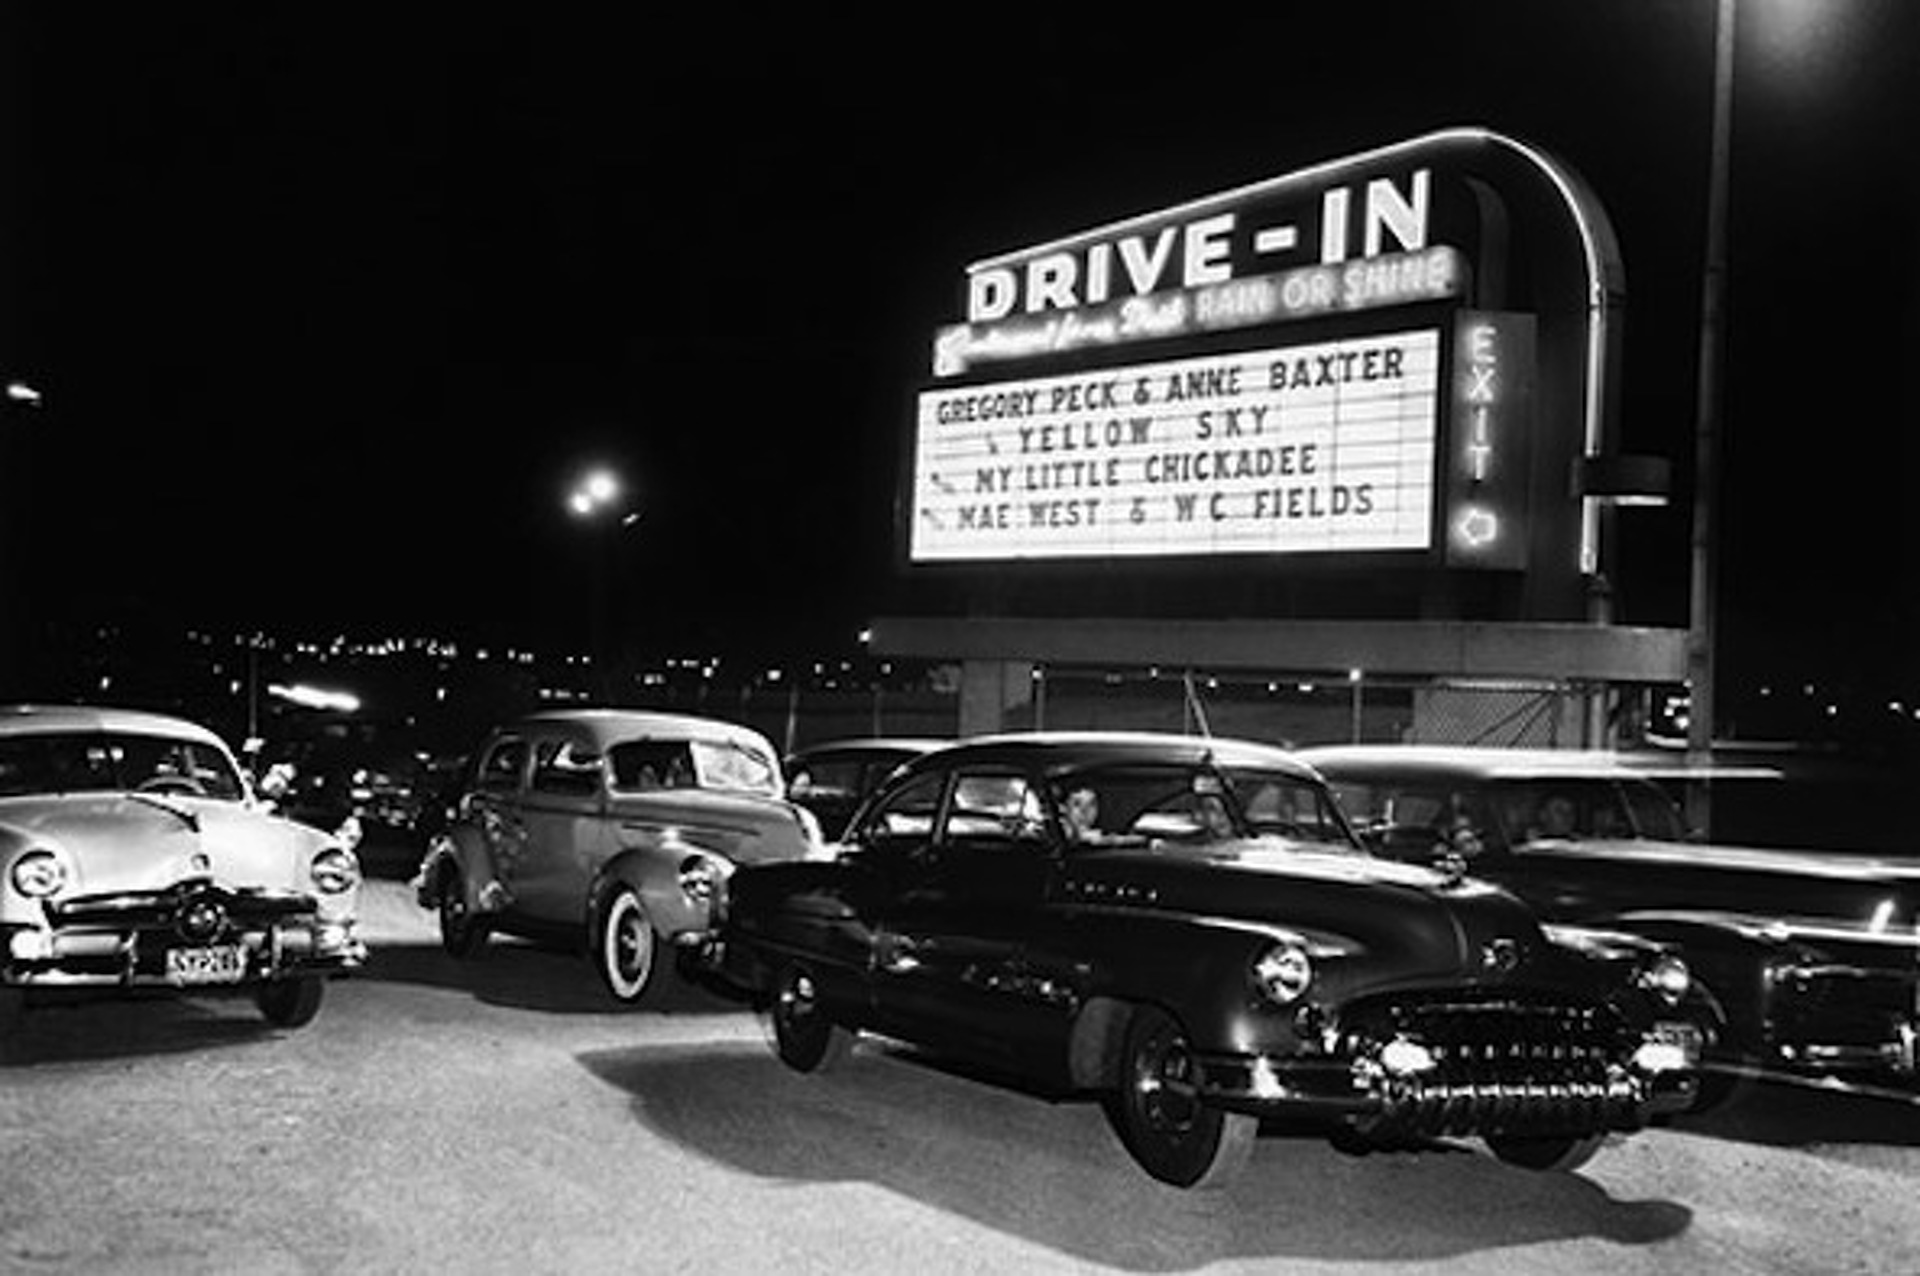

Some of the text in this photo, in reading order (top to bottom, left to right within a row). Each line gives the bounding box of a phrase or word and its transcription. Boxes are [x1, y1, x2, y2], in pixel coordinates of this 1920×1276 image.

[1196, 279, 1275, 322] RAIN
[1282, 268, 1337, 312] OR
[937, 347, 1404, 425] GREGORY PECK & ANNE BAXTER
[1469, 325, 1497, 481] EXIT
[1018, 405, 1269, 454] YELLOW SKY
[974, 443, 1317, 493] MY LITTLE CHICKADEE
[956, 503, 1010, 530] MAE
[1028, 499, 1101, 527] WEST
[1130, 497, 1146, 525] &
[1253, 483, 1374, 520] FIELDS
